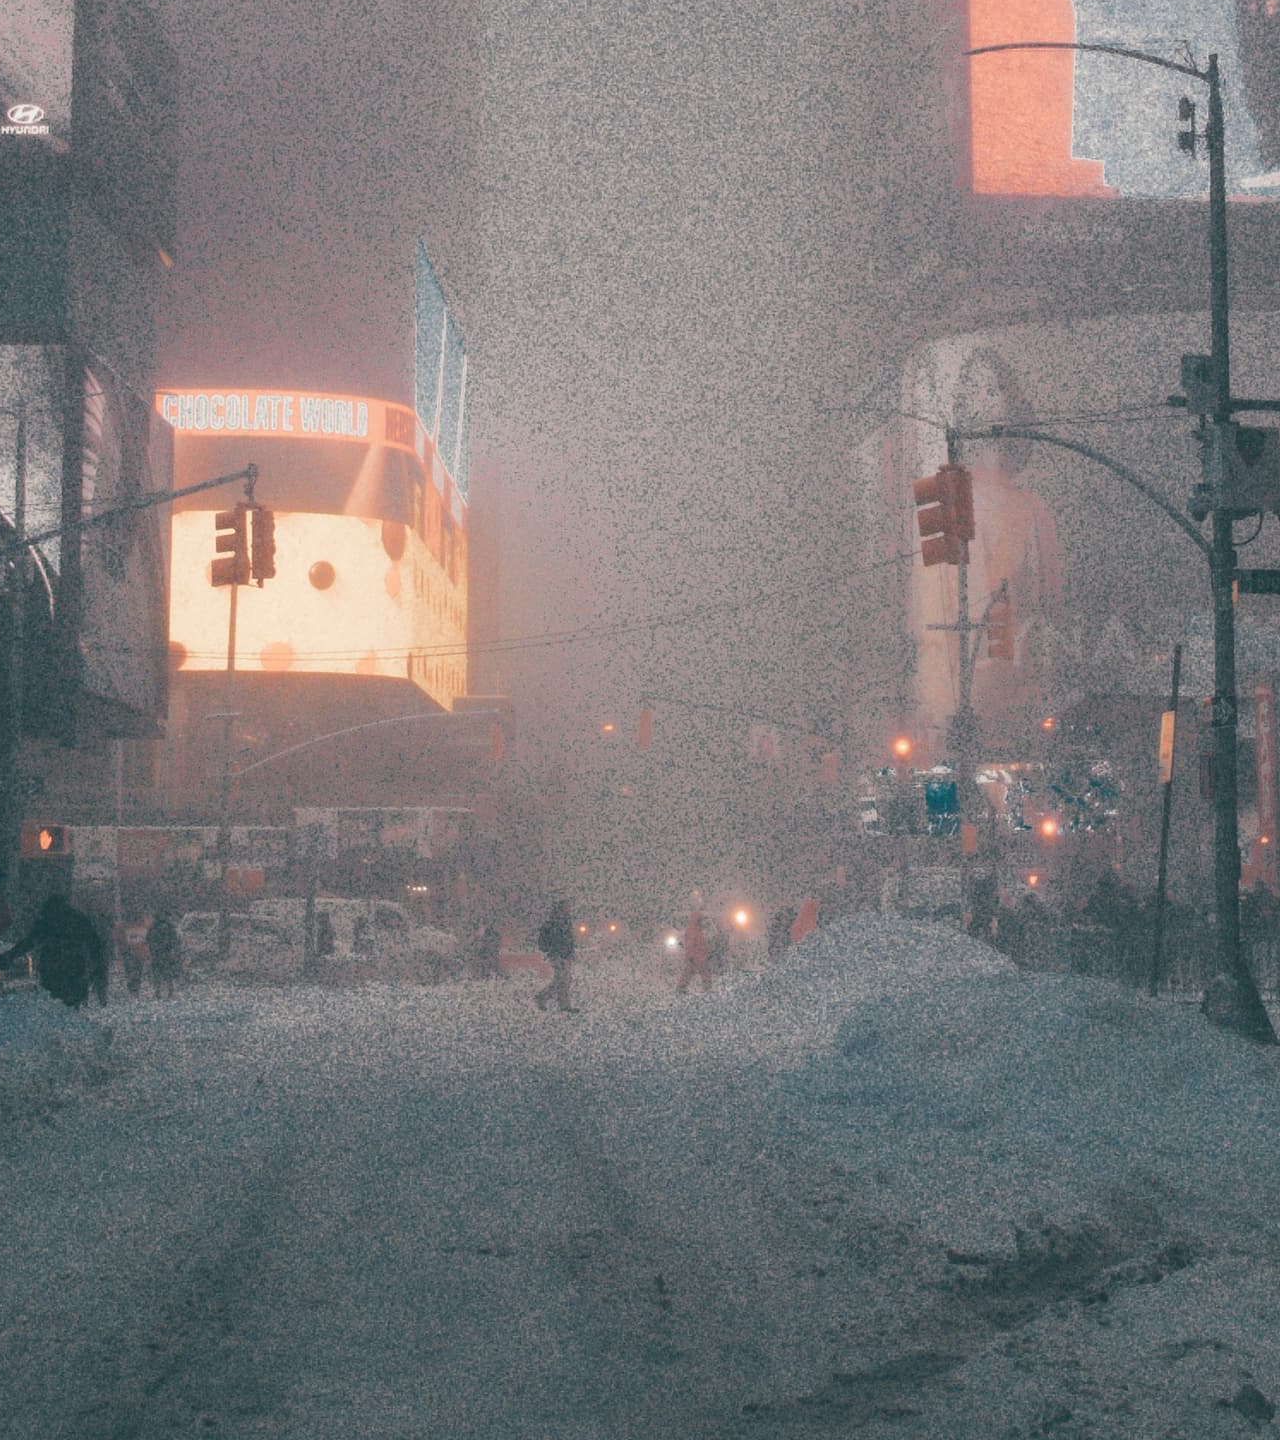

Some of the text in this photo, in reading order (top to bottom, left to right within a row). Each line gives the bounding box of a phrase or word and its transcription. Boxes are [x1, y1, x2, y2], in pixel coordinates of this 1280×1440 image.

[0, 124, 51, 136] HYUNDAI
[162, 393, 295, 432] CHOCOLATE
[299, 396, 369, 438] WORLD
